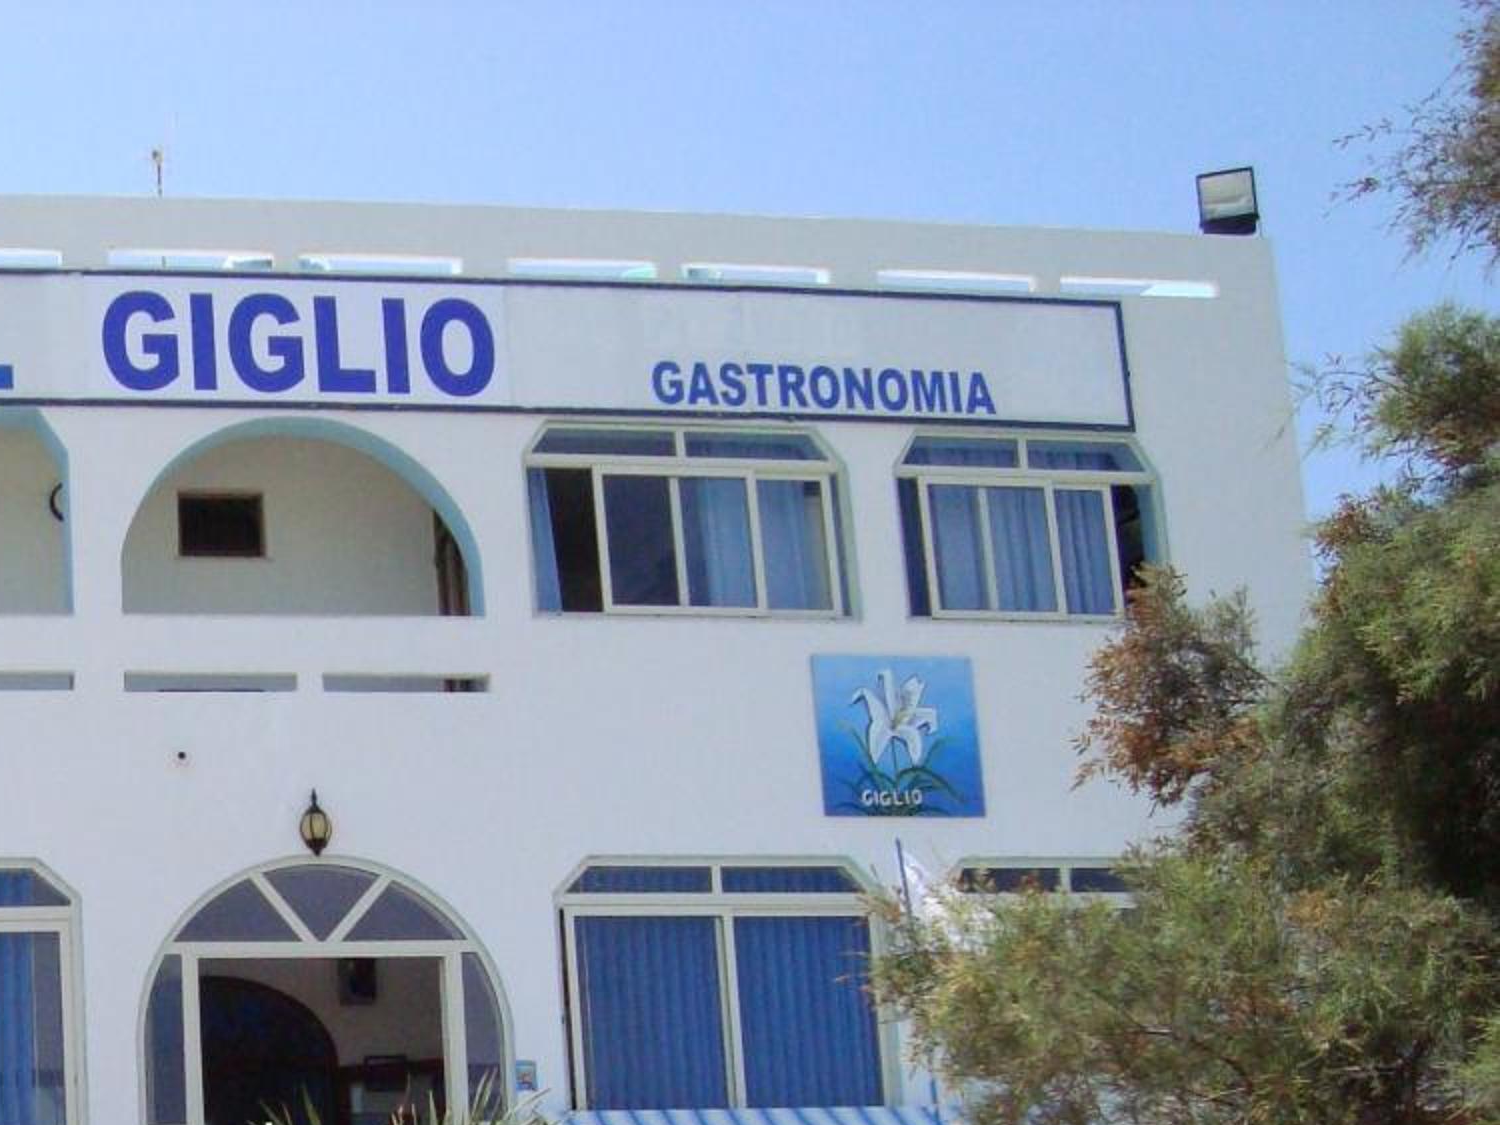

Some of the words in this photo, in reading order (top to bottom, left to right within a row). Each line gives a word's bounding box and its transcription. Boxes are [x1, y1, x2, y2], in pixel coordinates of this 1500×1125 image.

[101, 290, 496, 398] GIGLIO
[651, 360, 997, 415] GASTRONOMIA
[861, 788, 923, 806] GIGLIO
